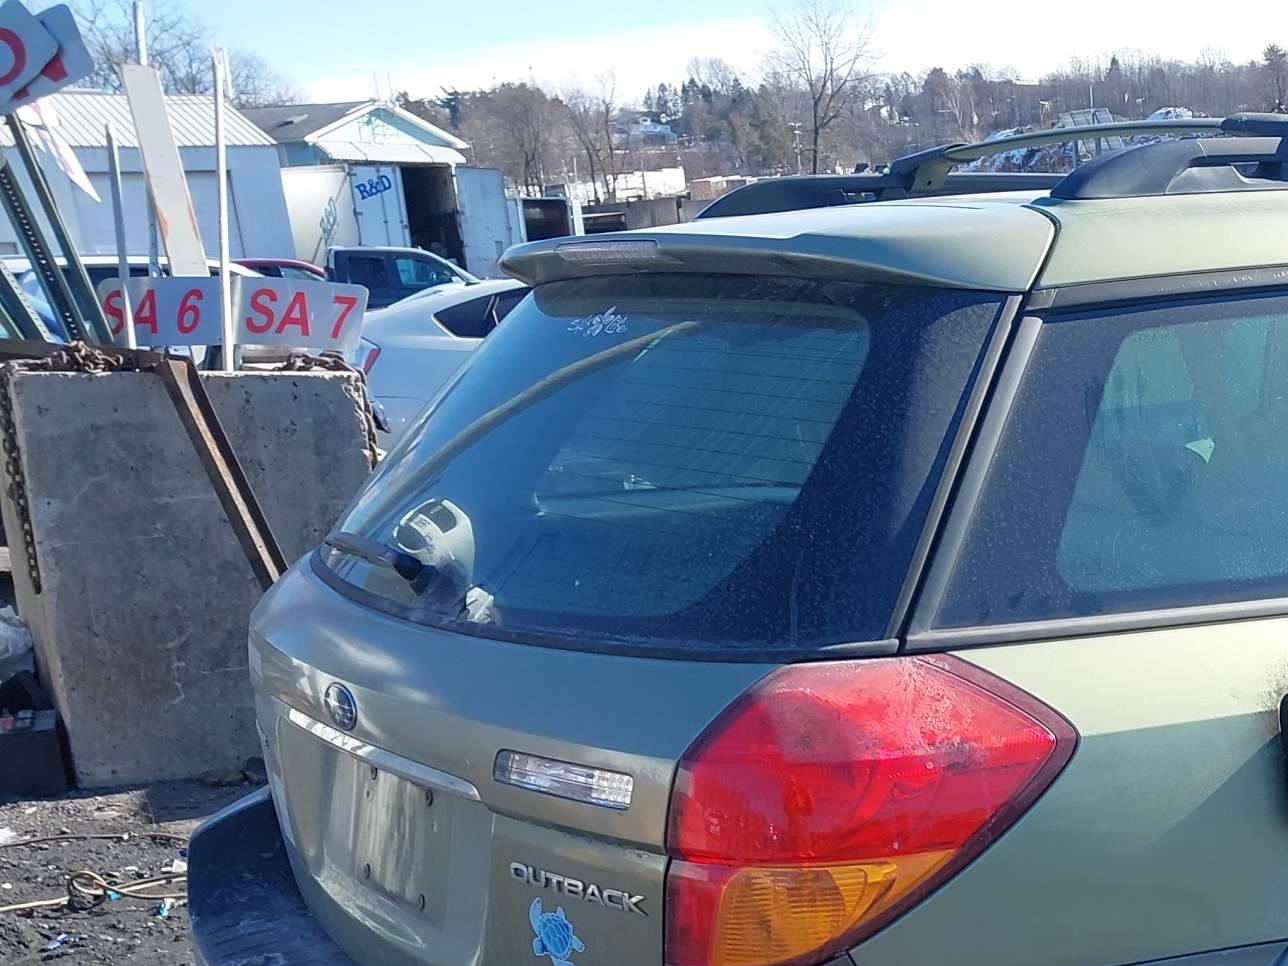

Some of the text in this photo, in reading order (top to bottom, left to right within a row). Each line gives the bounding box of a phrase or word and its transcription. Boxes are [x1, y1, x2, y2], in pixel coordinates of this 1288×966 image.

[354, 174, 392, 200] R&D
[103, 288, 203, 336] SA 6
[245, 287, 357, 339] SA 7
[509, 861, 649, 917] OUTBACK
